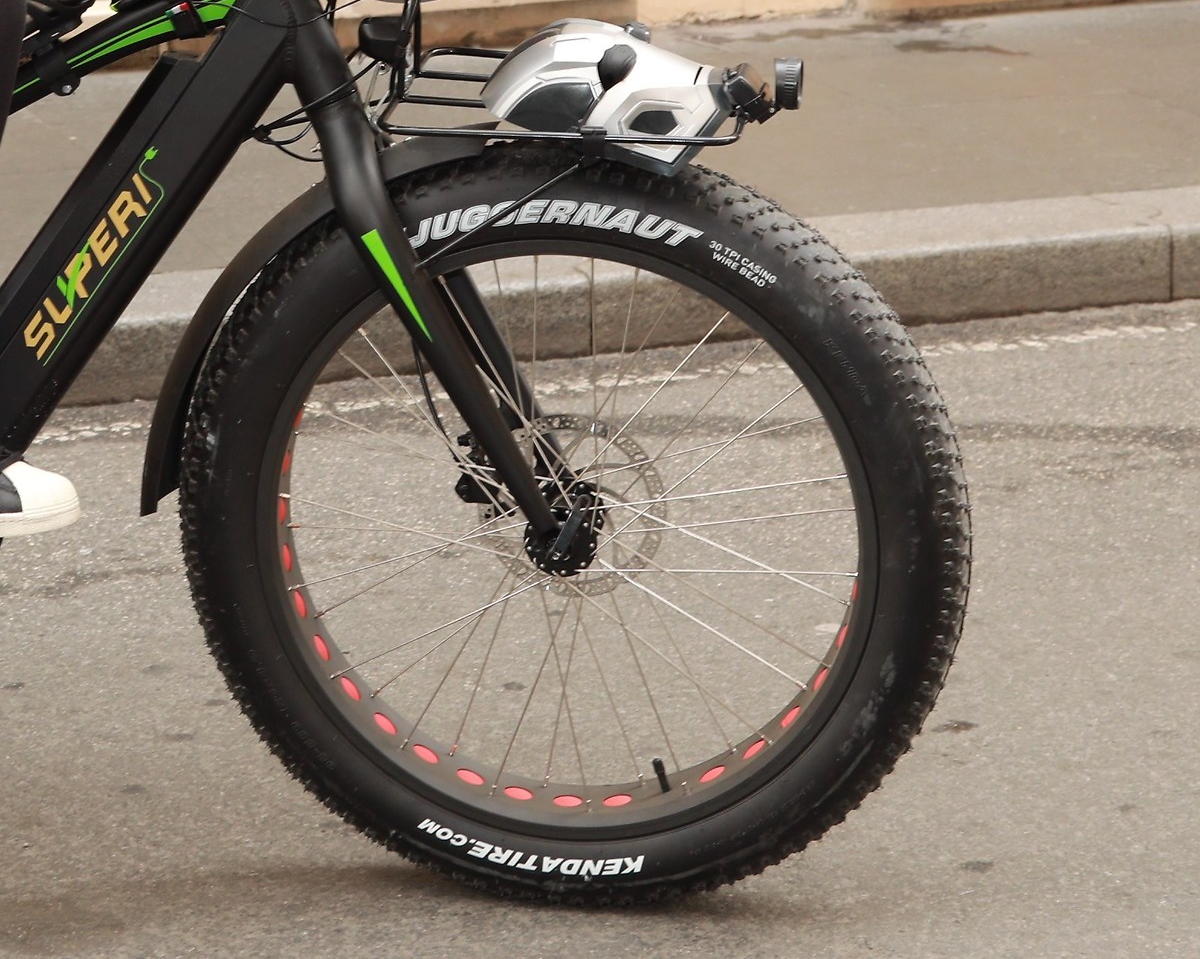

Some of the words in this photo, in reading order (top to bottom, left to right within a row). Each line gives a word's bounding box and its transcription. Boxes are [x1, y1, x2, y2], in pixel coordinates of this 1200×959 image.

[406, 199, 704, 249] JUGGERNAUT
[709, 240, 723, 252] 30
[724, 247, 741, 261] TPI
[740, 258, 778, 284] CASING
[712, 251, 740, 271] WIRE
[738, 267, 766, 288] BEAD
[417, 818, 645, 876] KENDATIRE.COM
